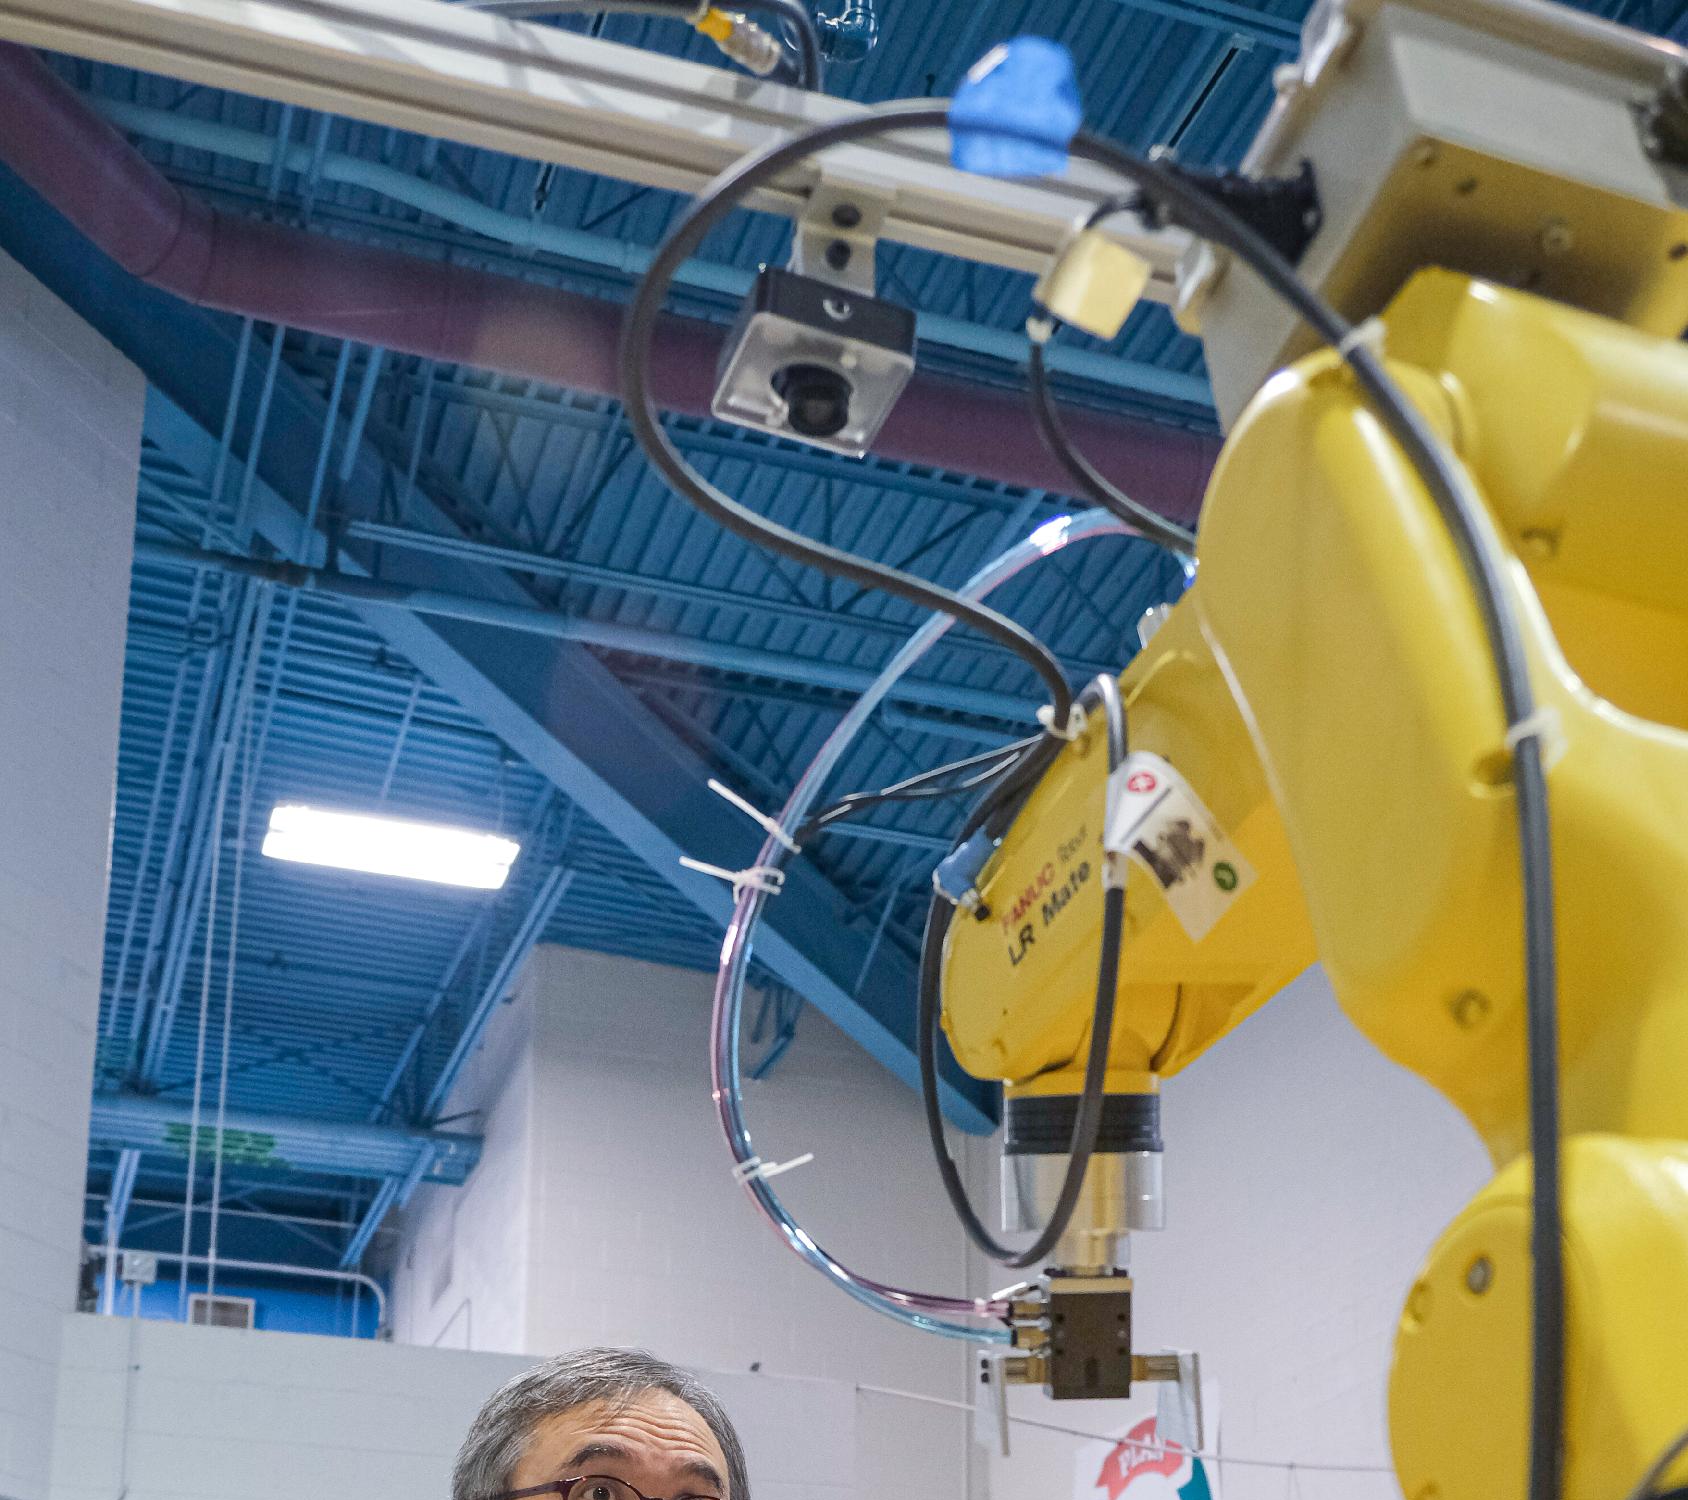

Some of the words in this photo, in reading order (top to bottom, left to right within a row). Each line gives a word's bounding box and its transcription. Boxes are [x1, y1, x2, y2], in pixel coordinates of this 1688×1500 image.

[1001, 861, 1055, 934] FANUC
[1008, 923, 1036, 967] LR
[1042, 861, 1090, 926] Mate
[1118, 1433, 1165, 1477] PLAN
